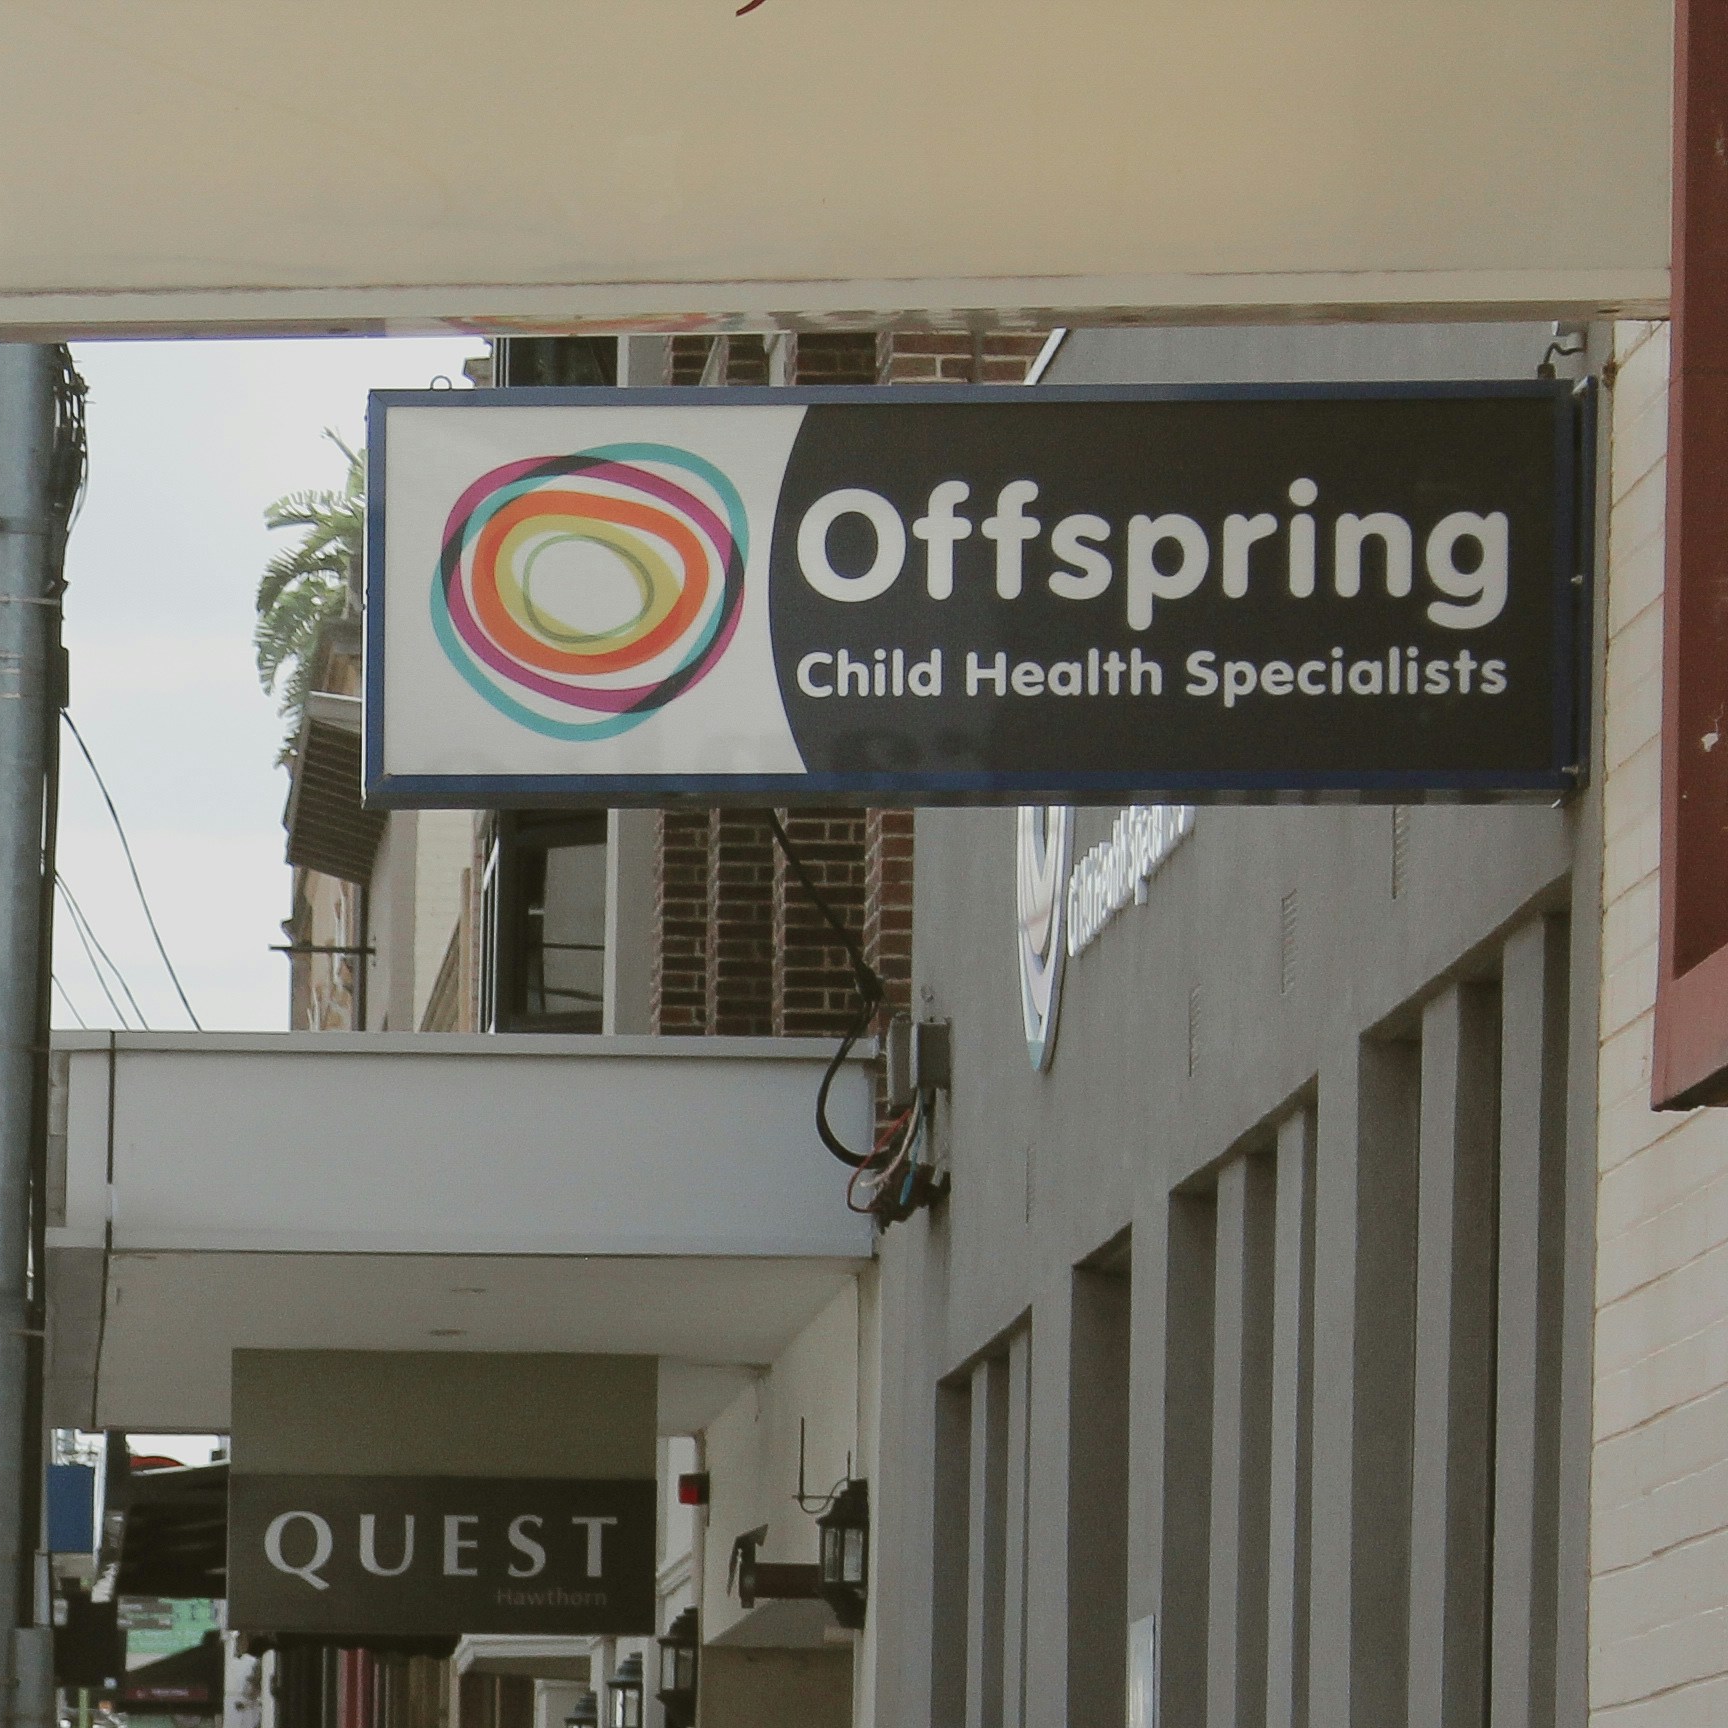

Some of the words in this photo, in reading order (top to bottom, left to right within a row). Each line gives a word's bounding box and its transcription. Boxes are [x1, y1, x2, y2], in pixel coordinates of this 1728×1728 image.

[796, 476, 1508, 630] Offspring
[796, 646, 942, 699] Child
[965, 646, 1163, 698] Health
[1184, 646, 1508, 708] Specialists
[263, 1510, 618, 1590] QUEST
[497, 1587, 608, 1606] Hawthorn
